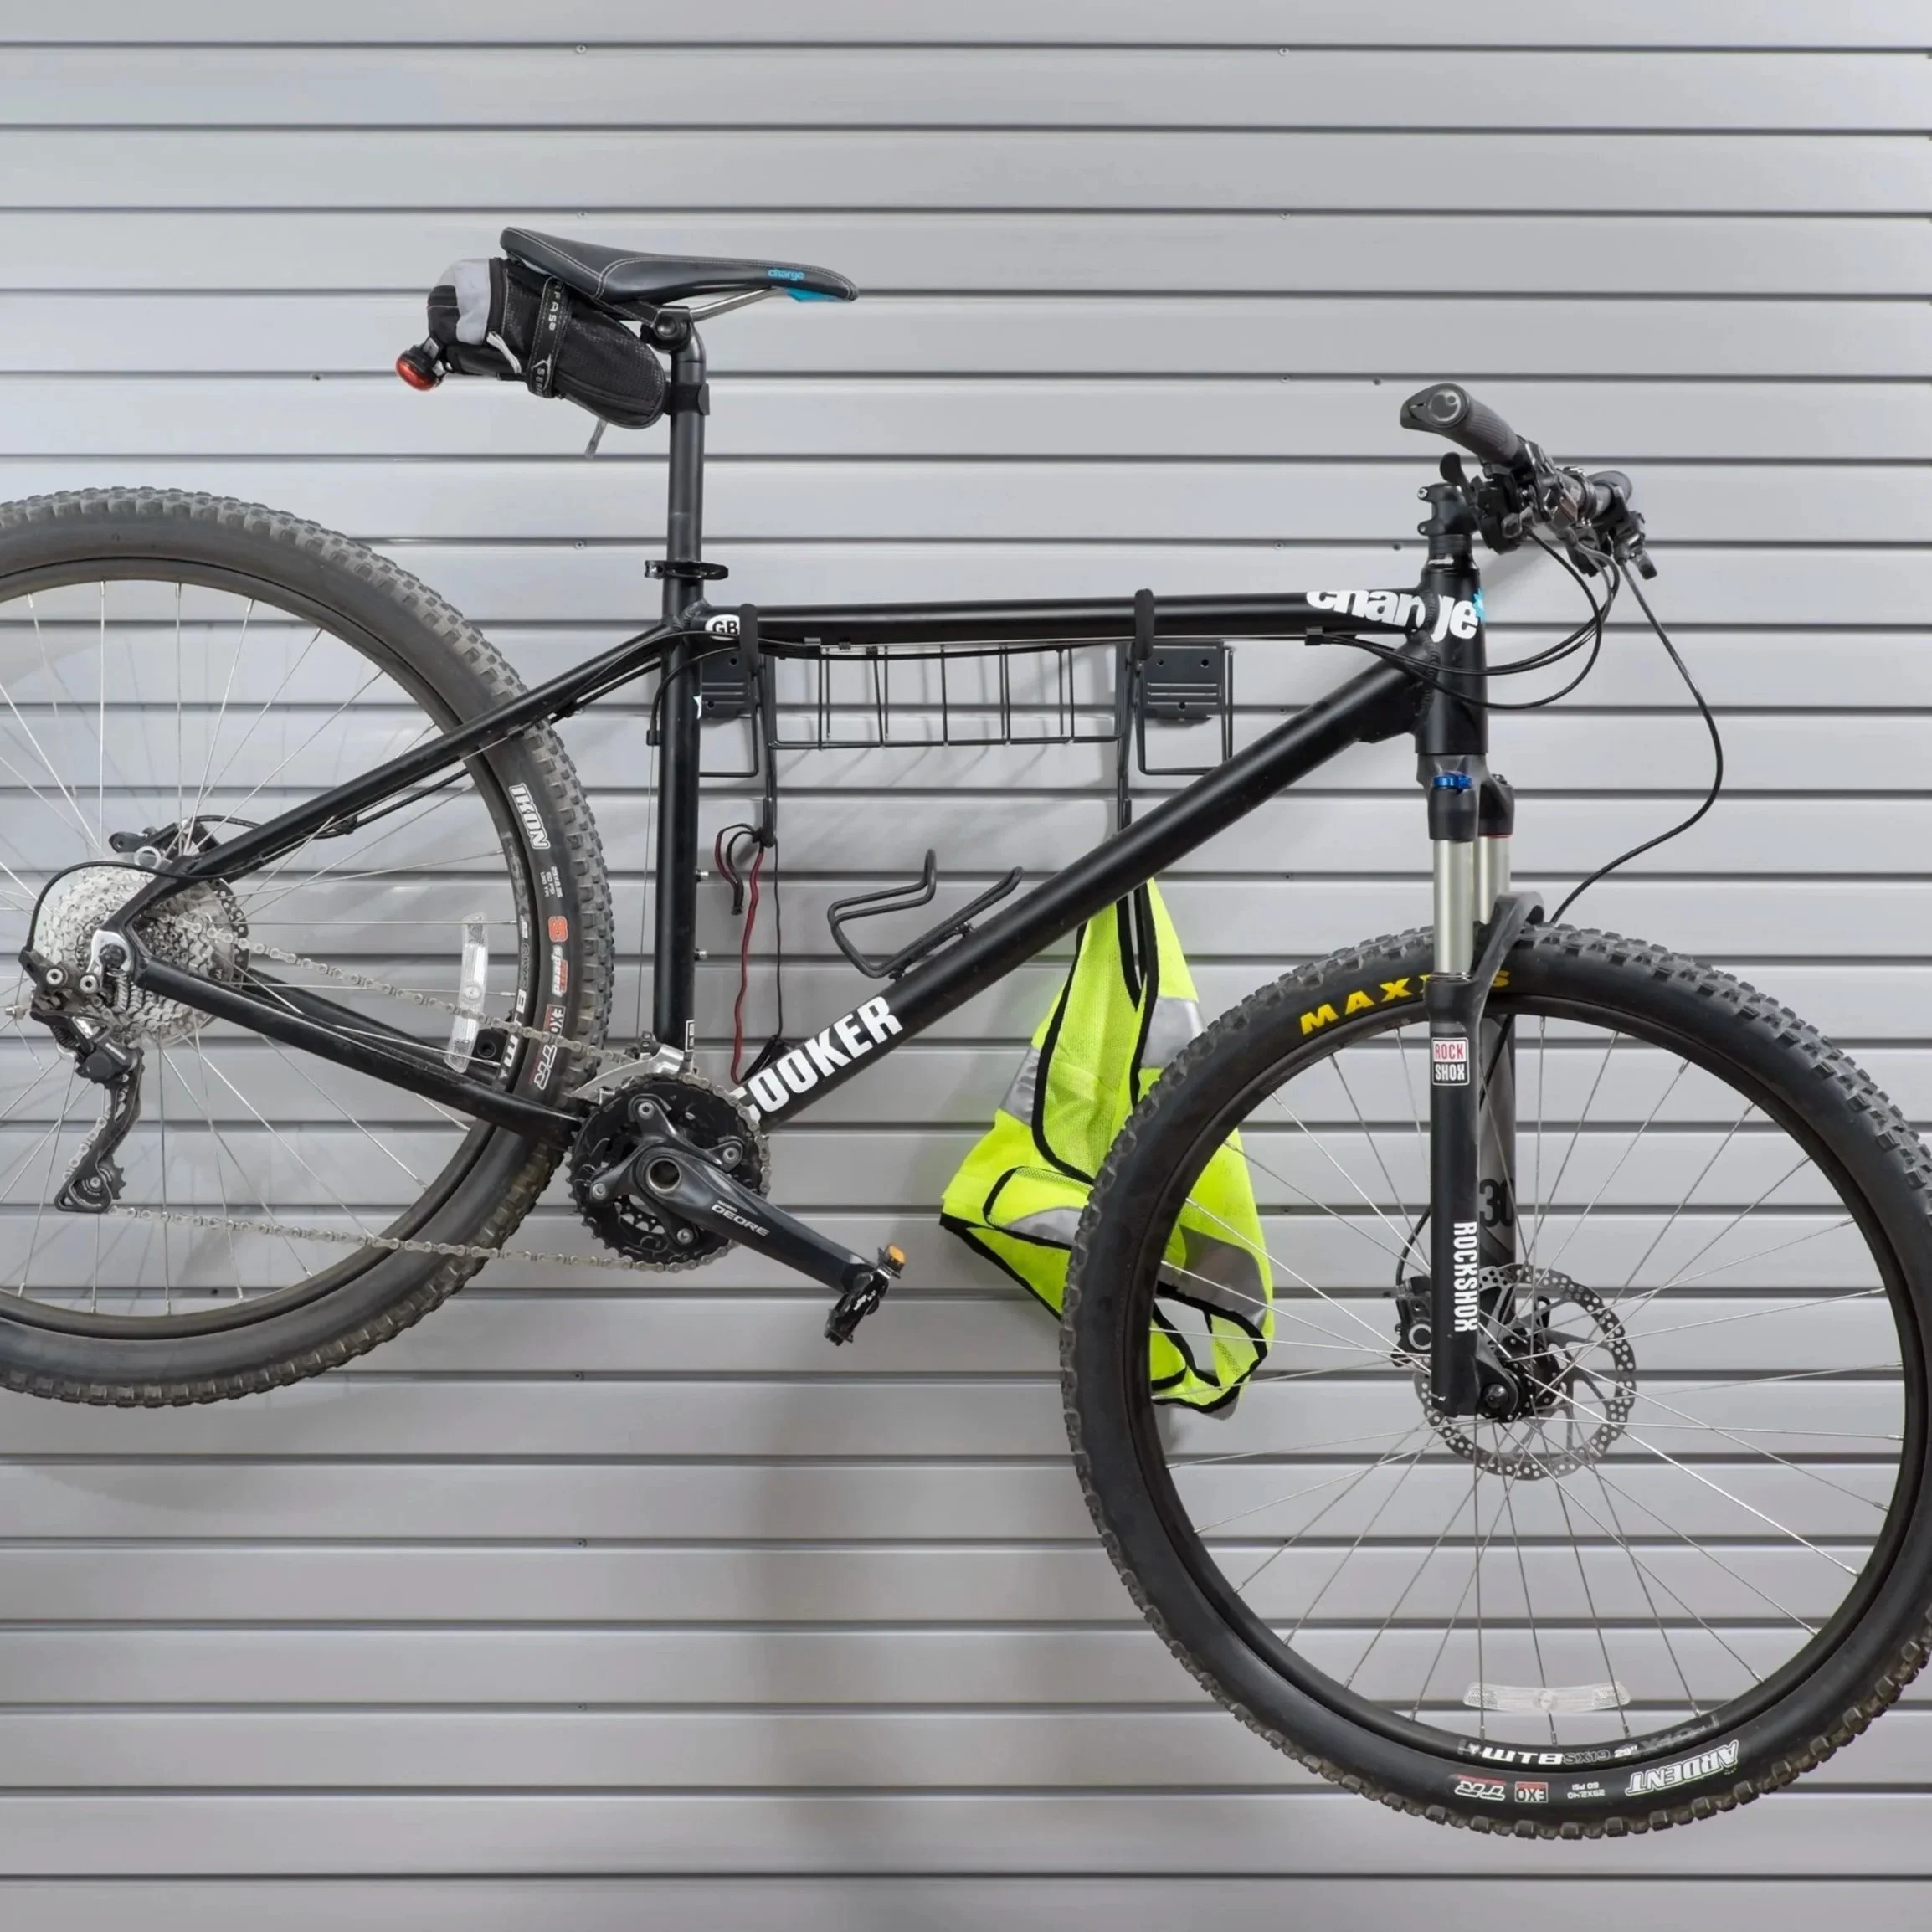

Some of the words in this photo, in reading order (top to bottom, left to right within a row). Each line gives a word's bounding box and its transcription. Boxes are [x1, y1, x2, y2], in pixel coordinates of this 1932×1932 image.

[768, 268, 804, 281] charge
[712, 620, 738, 635] GB
[508, 783, 551, 850] IKON
[1300, 970, 1509, 1035] MAXS
[1434, 1043, 1464, 1060] ROCK
[534, 1044, 558, 1091] TR
[1435, 1063, 1465, 1082] SHOX
[712, 1204, 770, 1236] DEORE
[1453, 1221, 1479, 1333] ROCKSHOX
[1482, 1746, 1564, 1765] WTB
[1563, 1748, 1611, 1765] SX19
[1625, 1739, 1739, 1796] ARDENT
[1455, 1780, 1506, 1801] TR
[1516, 1786, 1546, 1801] EXO
